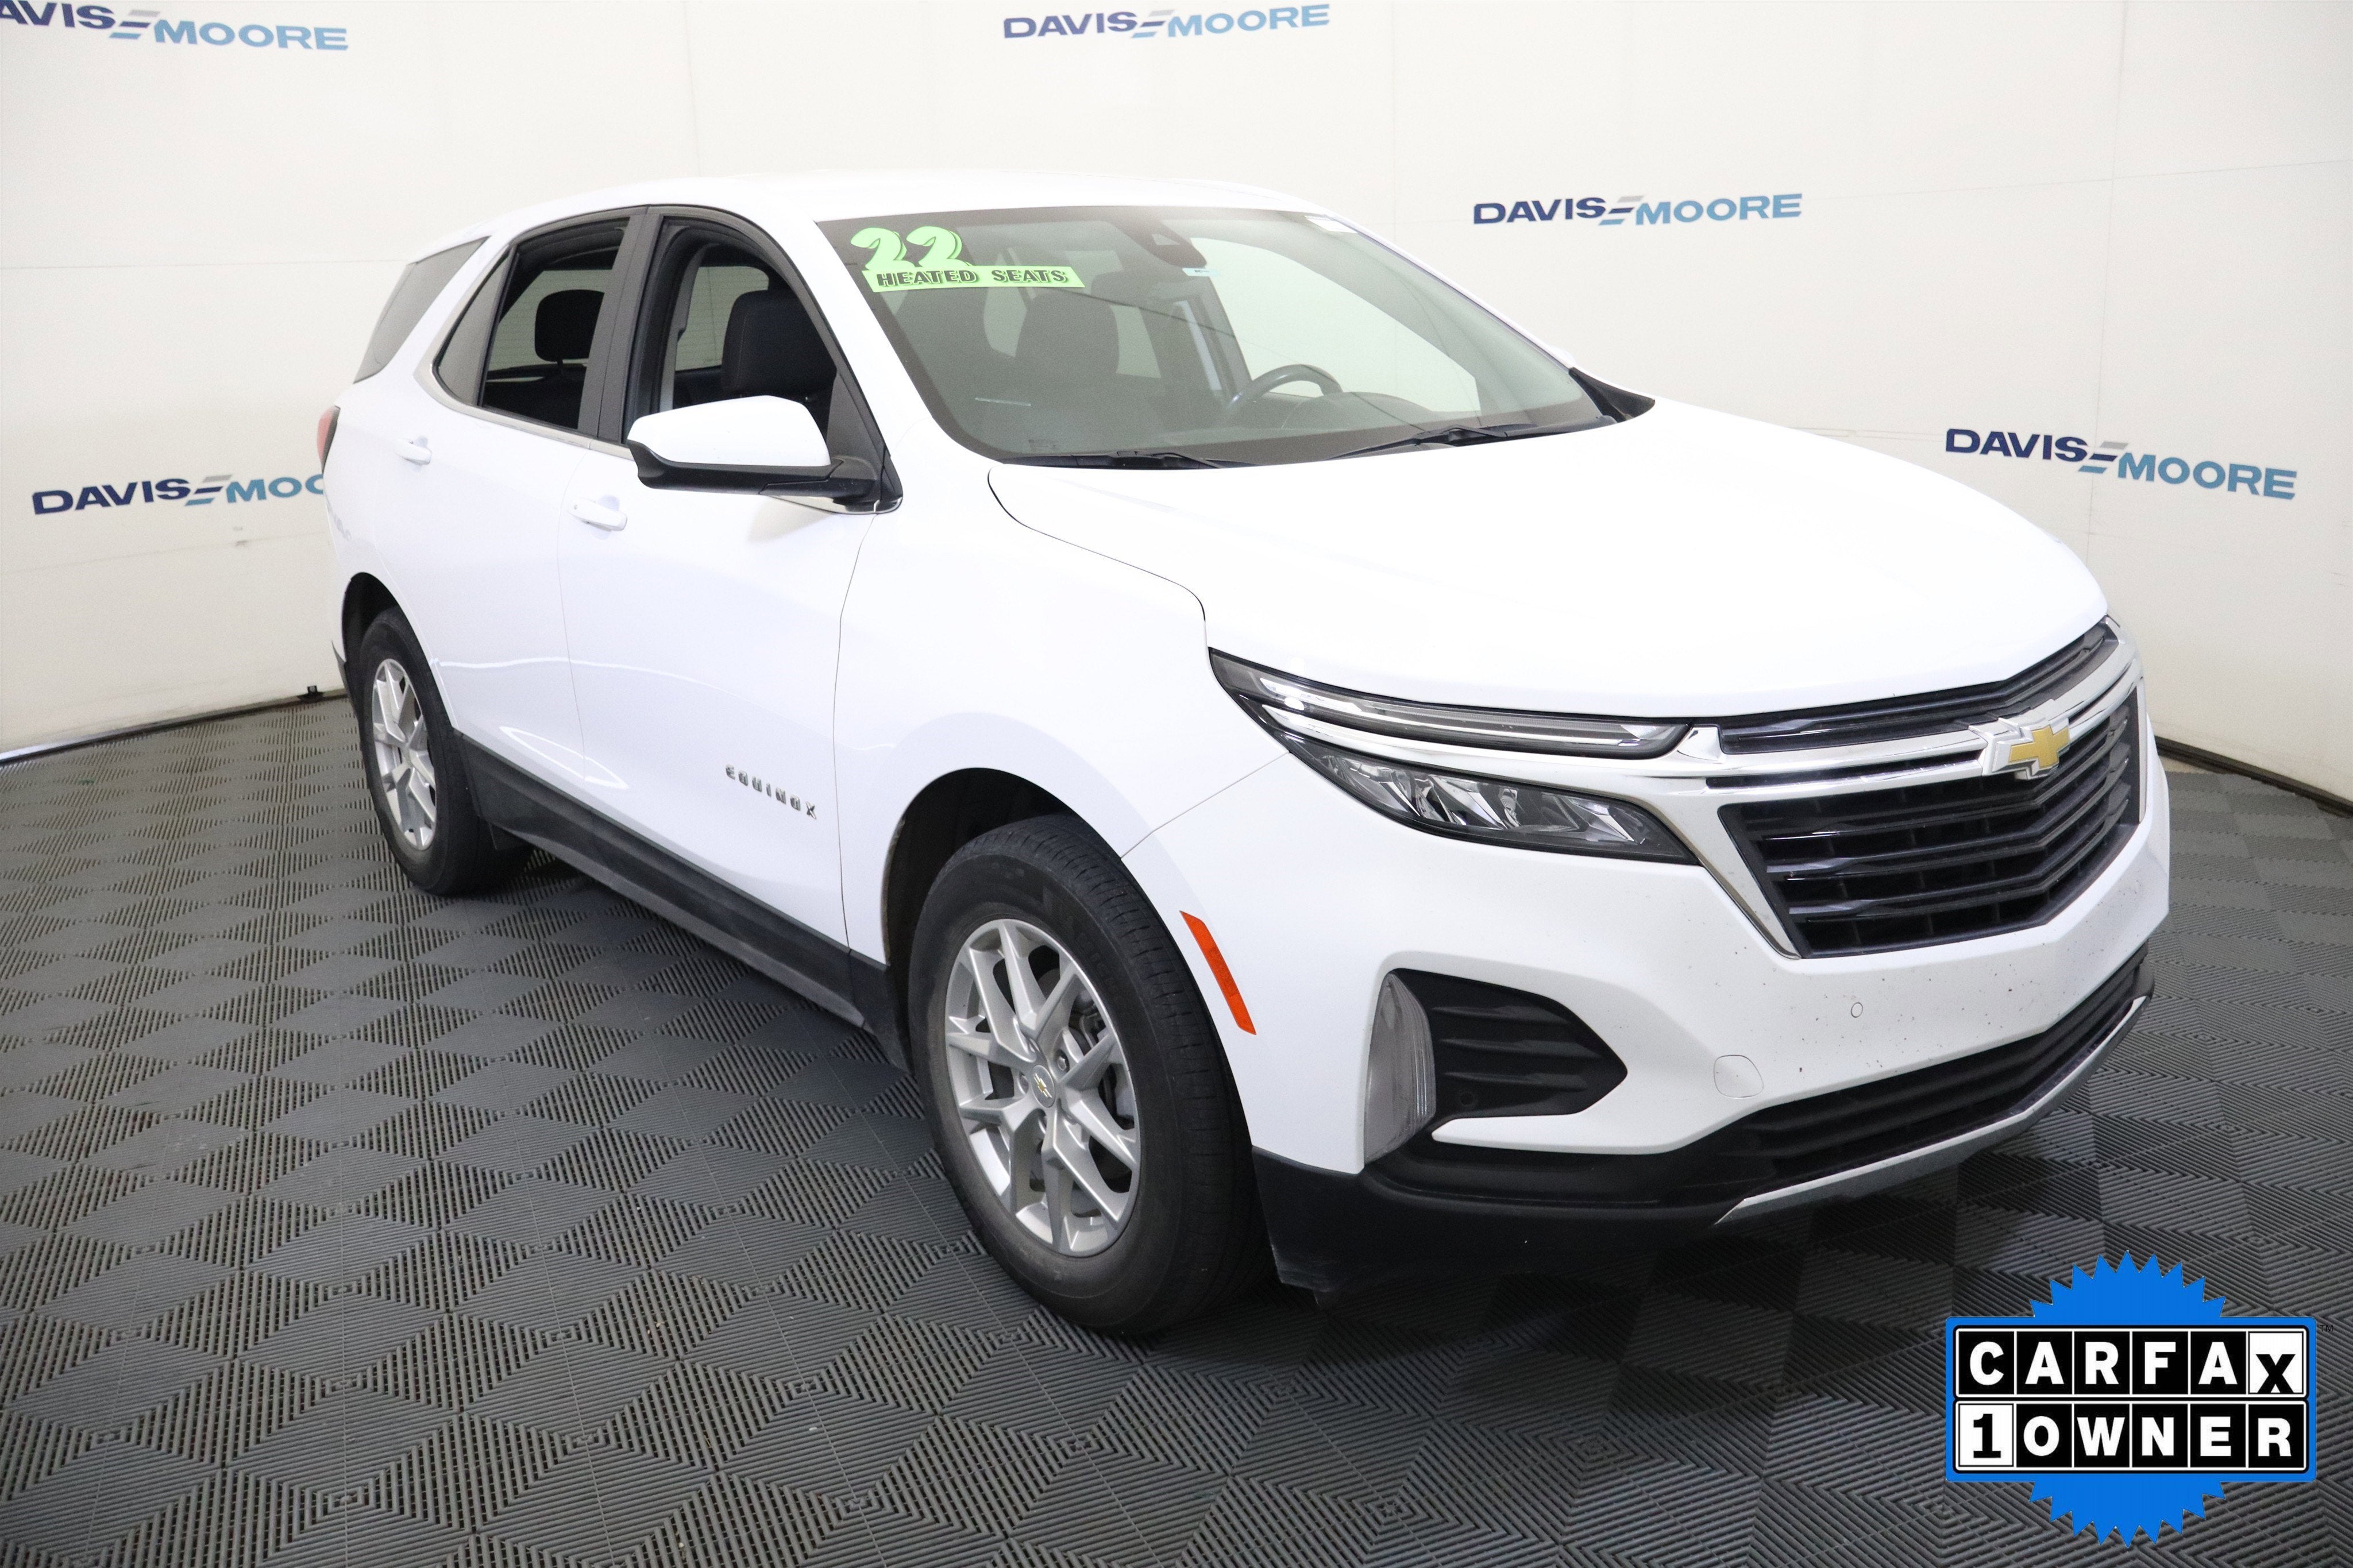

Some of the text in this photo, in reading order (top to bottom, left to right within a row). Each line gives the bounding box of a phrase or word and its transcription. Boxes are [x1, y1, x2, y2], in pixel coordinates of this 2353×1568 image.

[153, 19, 348, 51] MOORE
[1004, 4, 1330, 39] DAVIS MOORE
[1473, 193, 1802, 226] DAVIS MOORE
[850, 226, 971, 270] 22
[876, 269, 1069, 287] HEATED SEATS
[1946, 428, 2297, 500] DAVIS MOORE
[33, 478, 190, 515] DAVIS
[725, 764, 817, 820] EQUINOX
